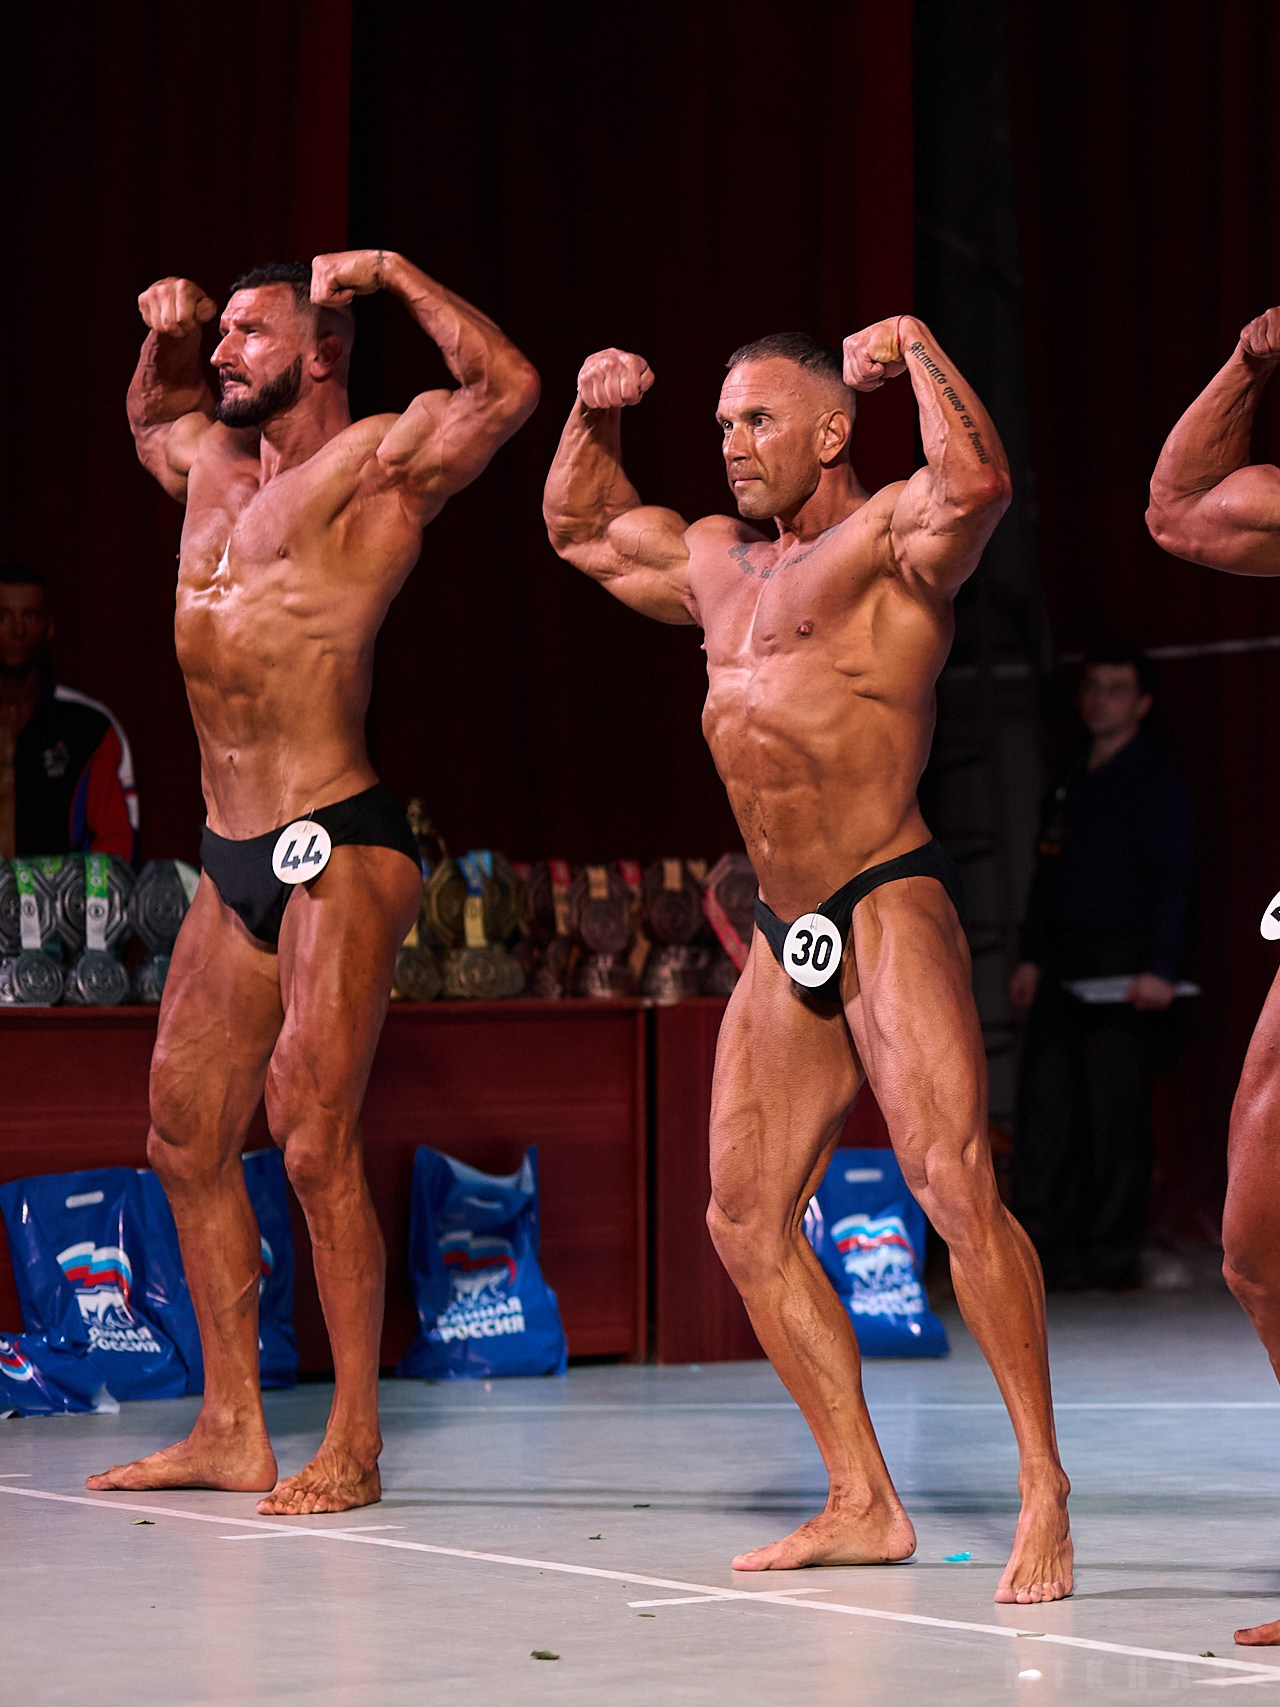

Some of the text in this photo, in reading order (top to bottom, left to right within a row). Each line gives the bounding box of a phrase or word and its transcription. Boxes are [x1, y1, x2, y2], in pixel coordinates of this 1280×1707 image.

[281, 834, 323, 870] 44
[791, 929, 833, 971] 30
[440, 1314, 525, 1343] РОССИЯ
